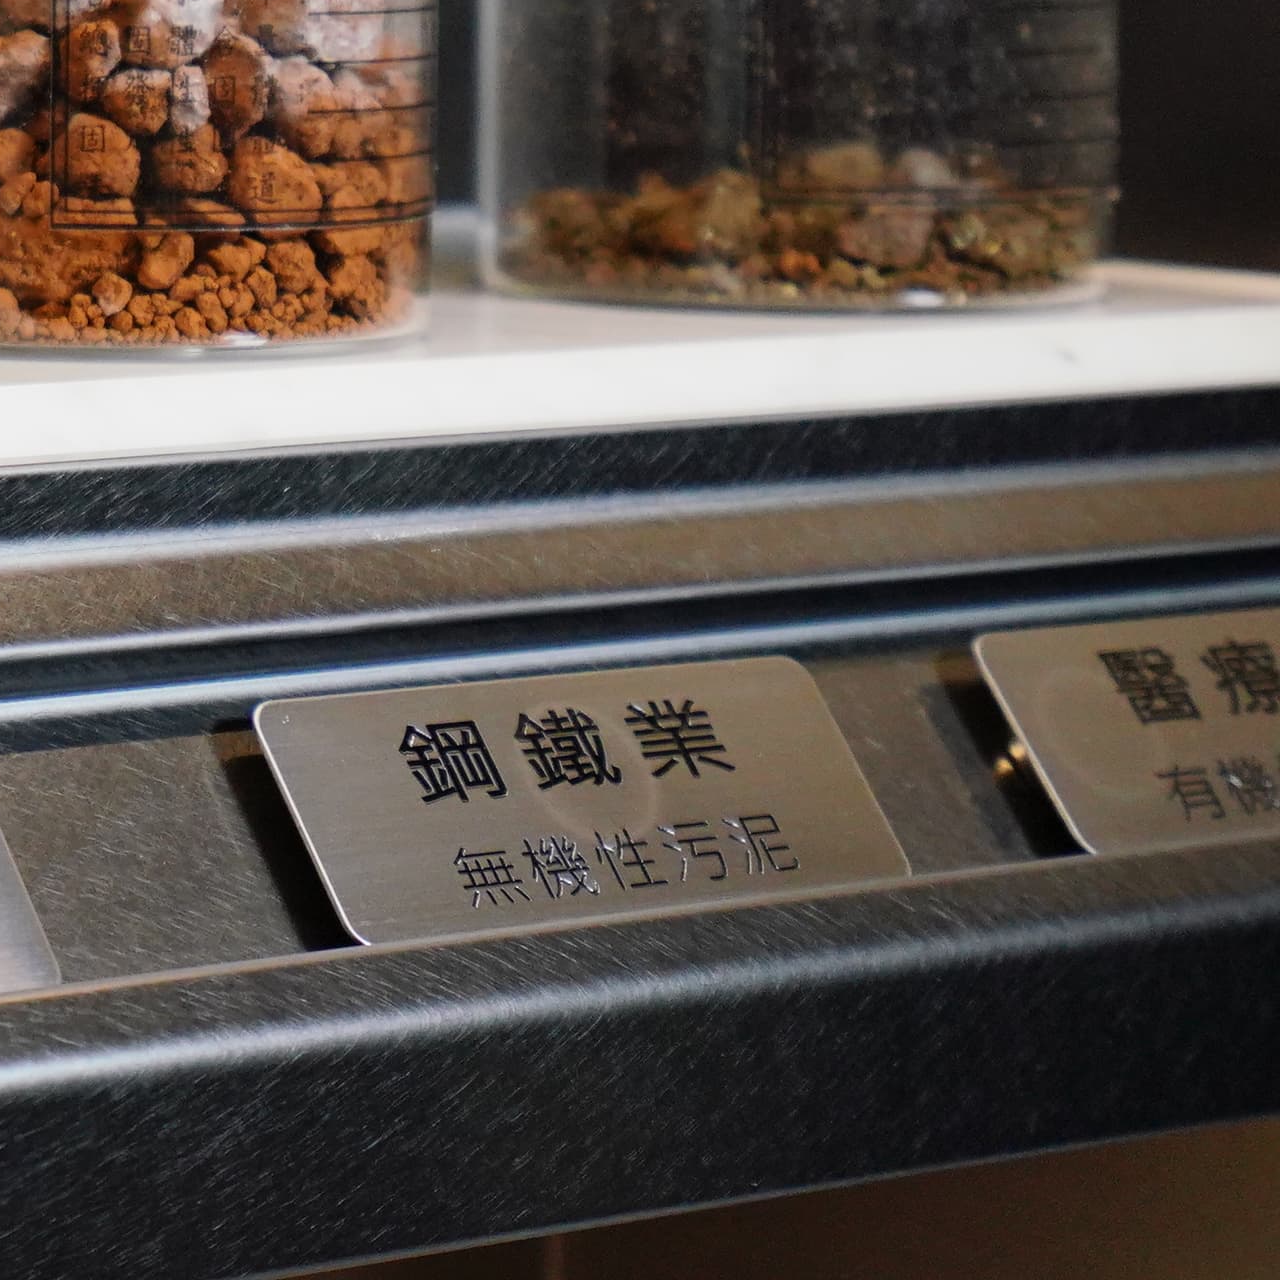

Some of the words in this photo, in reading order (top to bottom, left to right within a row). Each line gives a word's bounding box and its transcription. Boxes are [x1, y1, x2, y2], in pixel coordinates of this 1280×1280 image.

[397, 698, 736, 806] 鋼鐵業
[453, 812, 802, 910] 無機性污泥
